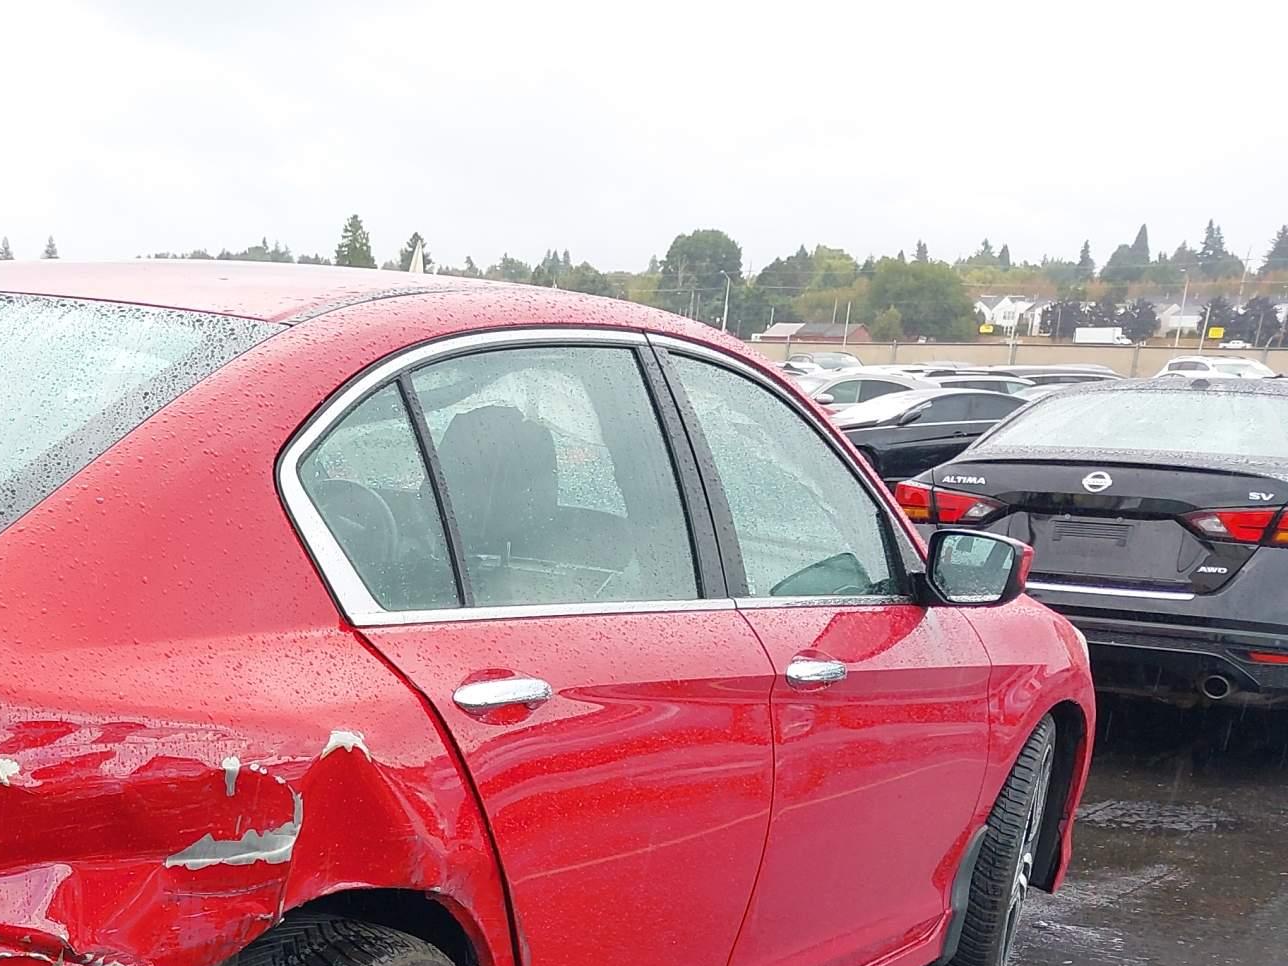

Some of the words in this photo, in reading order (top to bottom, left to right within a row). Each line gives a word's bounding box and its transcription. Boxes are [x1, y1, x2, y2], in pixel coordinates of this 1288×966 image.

[942, 475, 986, 485] ALTIMA
[1248, 491, 1275, 501] SV
[1197, 566, 1228, 574] AWD
